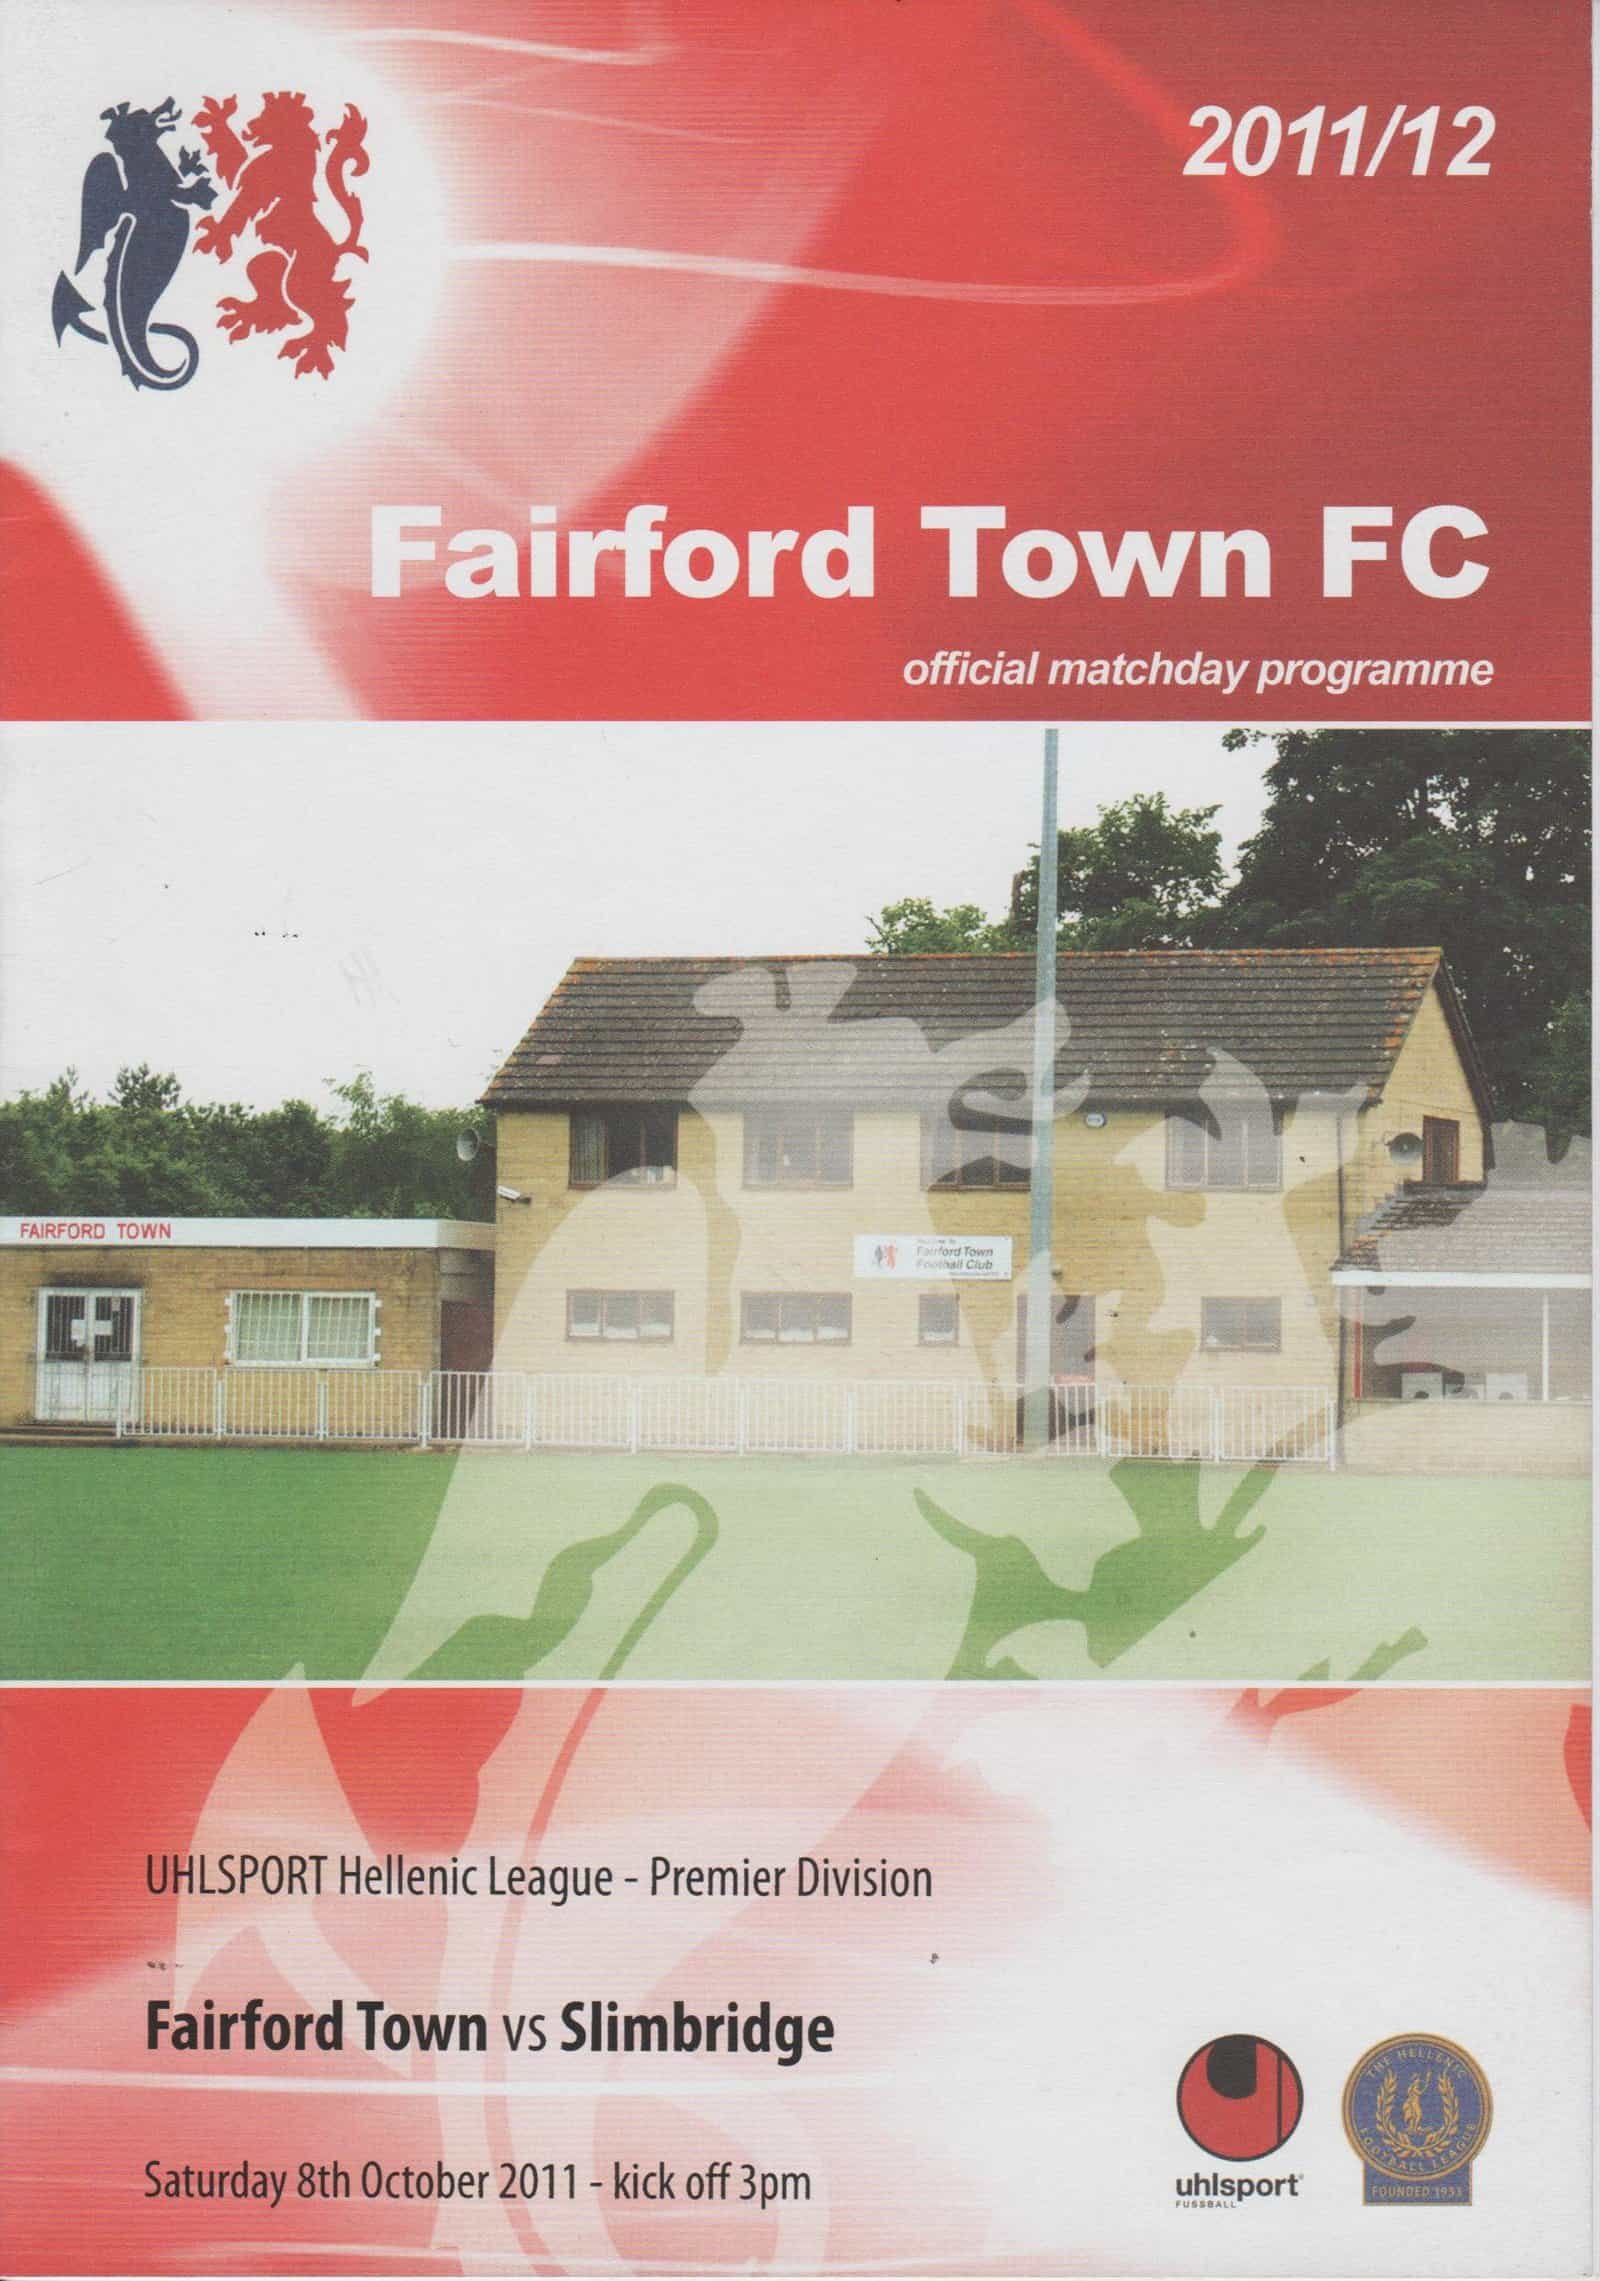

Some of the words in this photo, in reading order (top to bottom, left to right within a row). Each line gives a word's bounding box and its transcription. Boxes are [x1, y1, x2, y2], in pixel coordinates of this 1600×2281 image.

[1182, 104, 1496, 177] 2011/12
[371, 504, 875, 599] Fairford
[920, 505, 1271, 599] Town
[1322, 504, 1490, 599] FC
[903, 651, 1040, 686] official
[1048, 652, 1249, 694] matchday
[1256, 658, 1495, 695] programme
[20, 1223, 105, 1239] FAIRFORD
[117, 1223, 172, 1239] TOWN
[964, 1246, 994, 1257] Town
[966, 1259, 993, 1270] Club
[146, 1854, 328, 1895] UHLSPORT
[340, 1854, 477, 1896] Hellenic
[489, 1856, 613, 1906] League
[651, 1857, 786, 1896] Premier
[799, 1857, 933, 1897] Division
[146, 1999, 343, 2051] Fairford
[357, 2000, 487, 2051] Town
[503, 2014, 547, 2051] vs
[561, 2001, 834, 2066] Slimbridge
[1366, 2055, 1392, 2078] THE
[1396, 2048, 1467, 2079] HELLENIC
[145, 2160, 287, 2208] Saturday
[297, 2160, 350, 2199] 8th
[362, 2160, 489, 2199] October
[499, 2162, 576, 2200] 2011
[614, 2161, 675, 2200] kick
[686, 2161, 732, 2200] off
[739, 2163, 811, 2210] 3pm
[1175, 2172, 1299, 2202] uhlsport
[1371, 2185, 1430, 2198] FOUNDED
[1175, 2200, 1237, 2208] FUSSBALL
